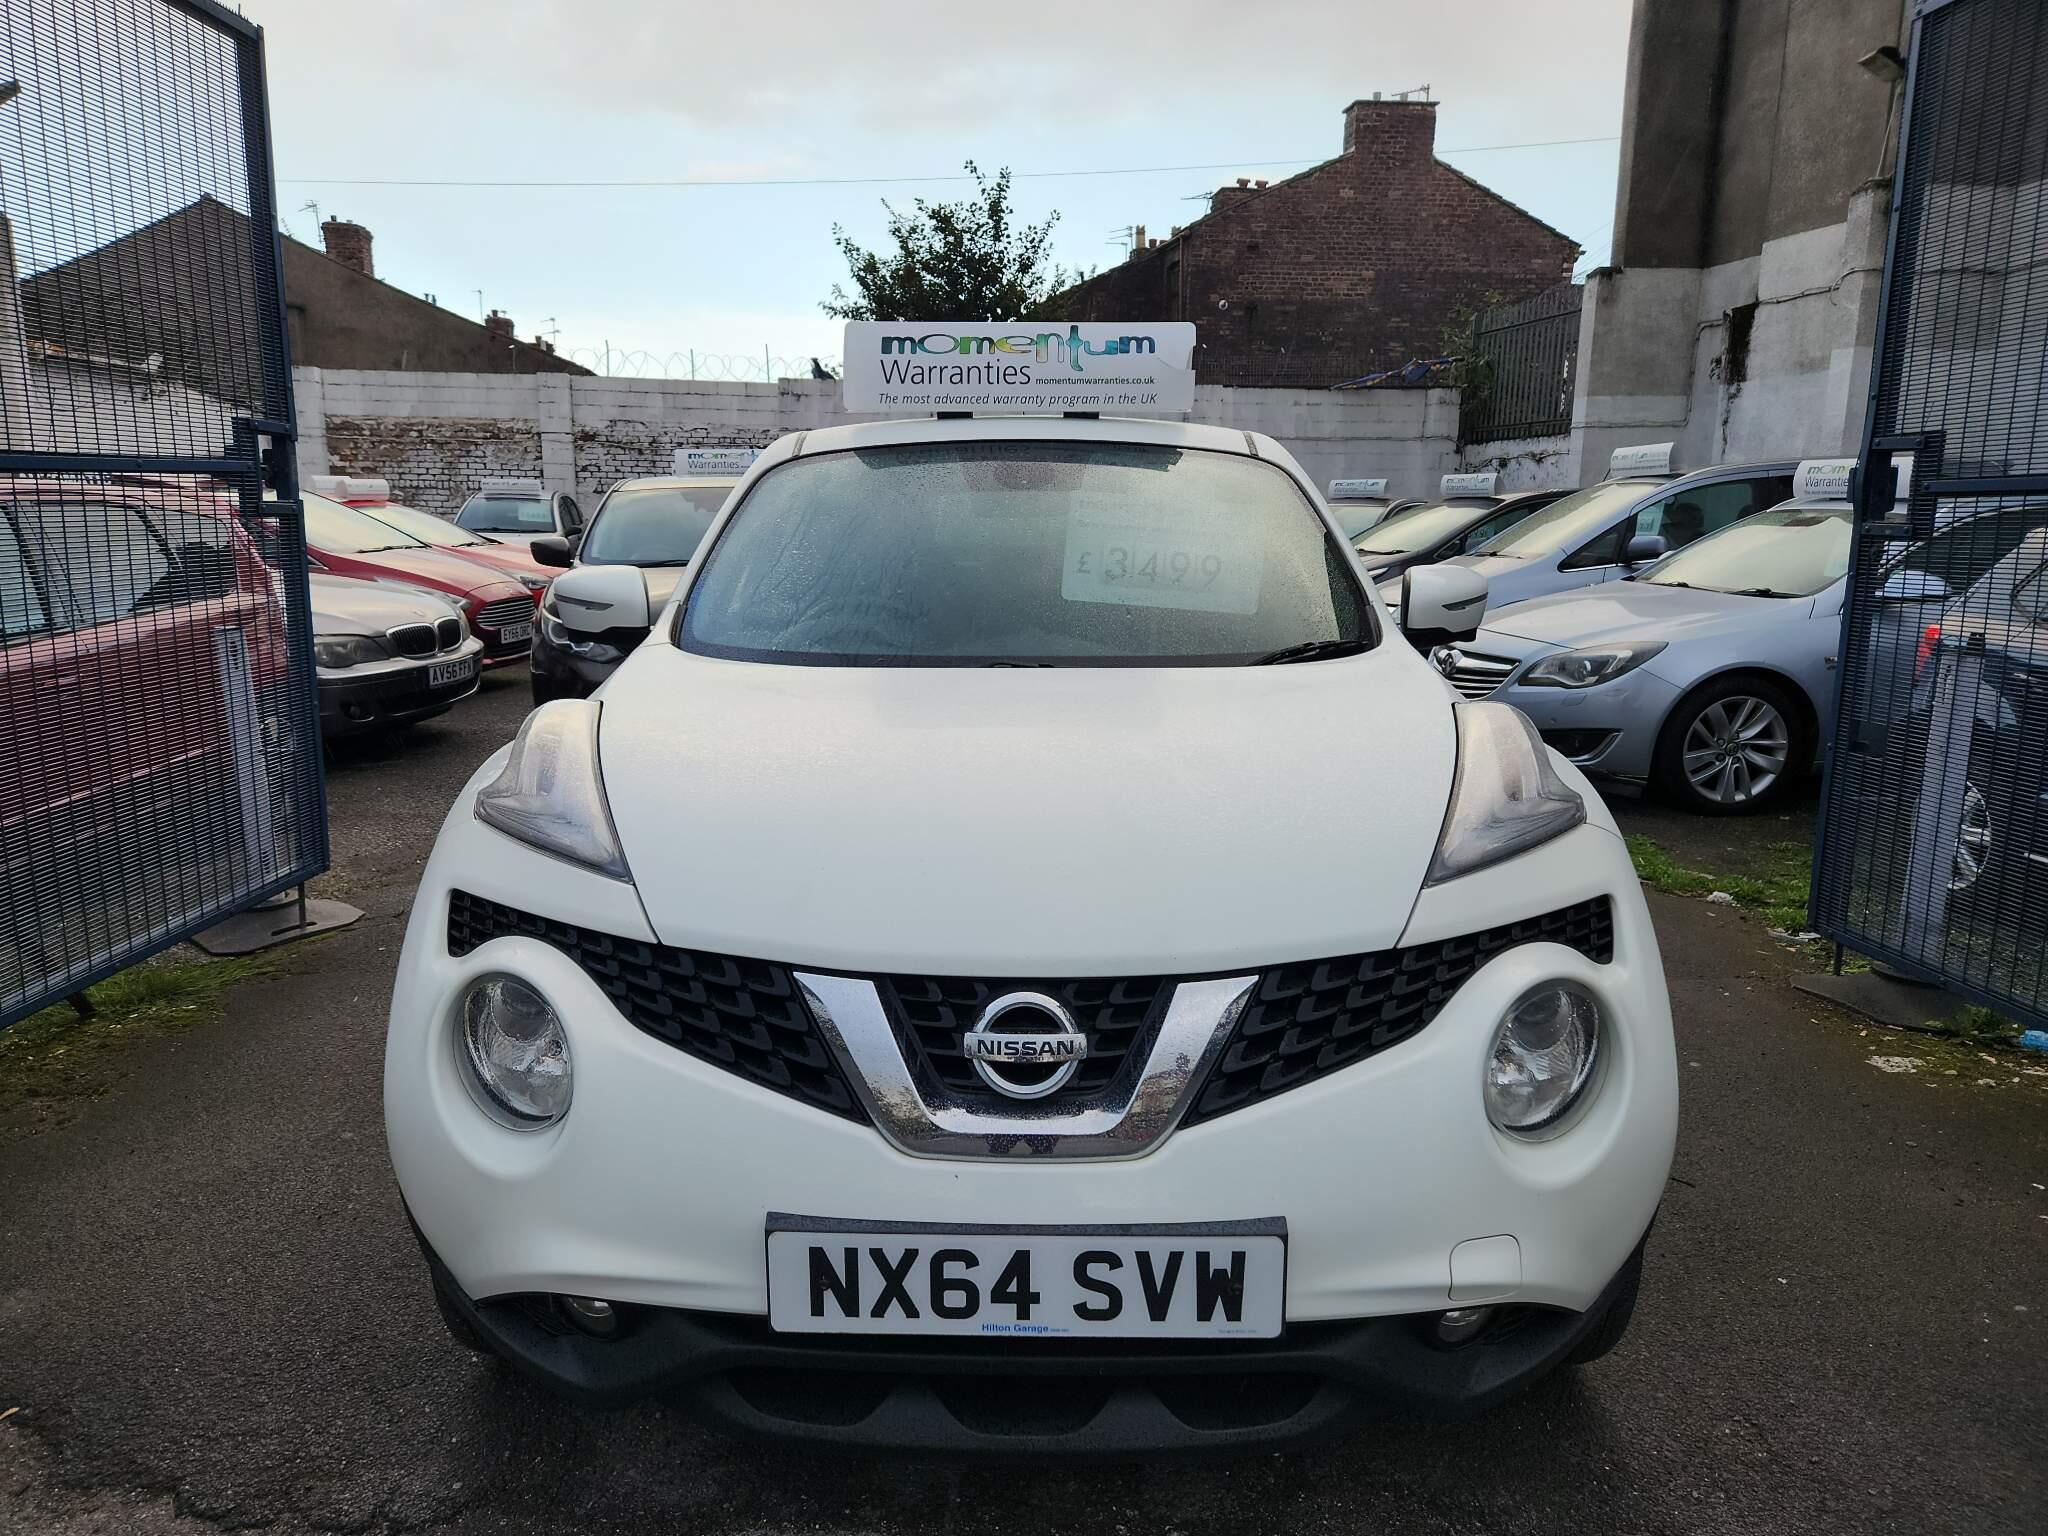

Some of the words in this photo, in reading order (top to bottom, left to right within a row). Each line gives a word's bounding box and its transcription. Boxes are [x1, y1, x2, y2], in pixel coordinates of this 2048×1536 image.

[881, 325, 1156, 371] momentum
[880, 358, 1031, 385] Warranties
[1035, 376, 1155, 385] momentumwarranties.co.uk
[879, 393, 899, 404] The
[902, 394, 930, 404] most
[934, 393, 990, 404] advanced
[993, 393, 1046, 407] warranty
[1048, 394, 1100, 407] program
[1103, 393, 1114, 405] in
[1118, 393, 1137, 405] the
[1140, 393, 1158, 405] UK
[688, 460, 739, 469] Warranties
[1805, 476, 1848, 488] Warrantie
[977, 1040, 1074, 1056] NISSAN
[808, 1246, 1041, 1320] NX64
[1072, 1250, 1247, 1322] SVW
[982, 1323, 1011, 1332] Hilton
[1013, 1323, 1049, 1334] Garage
